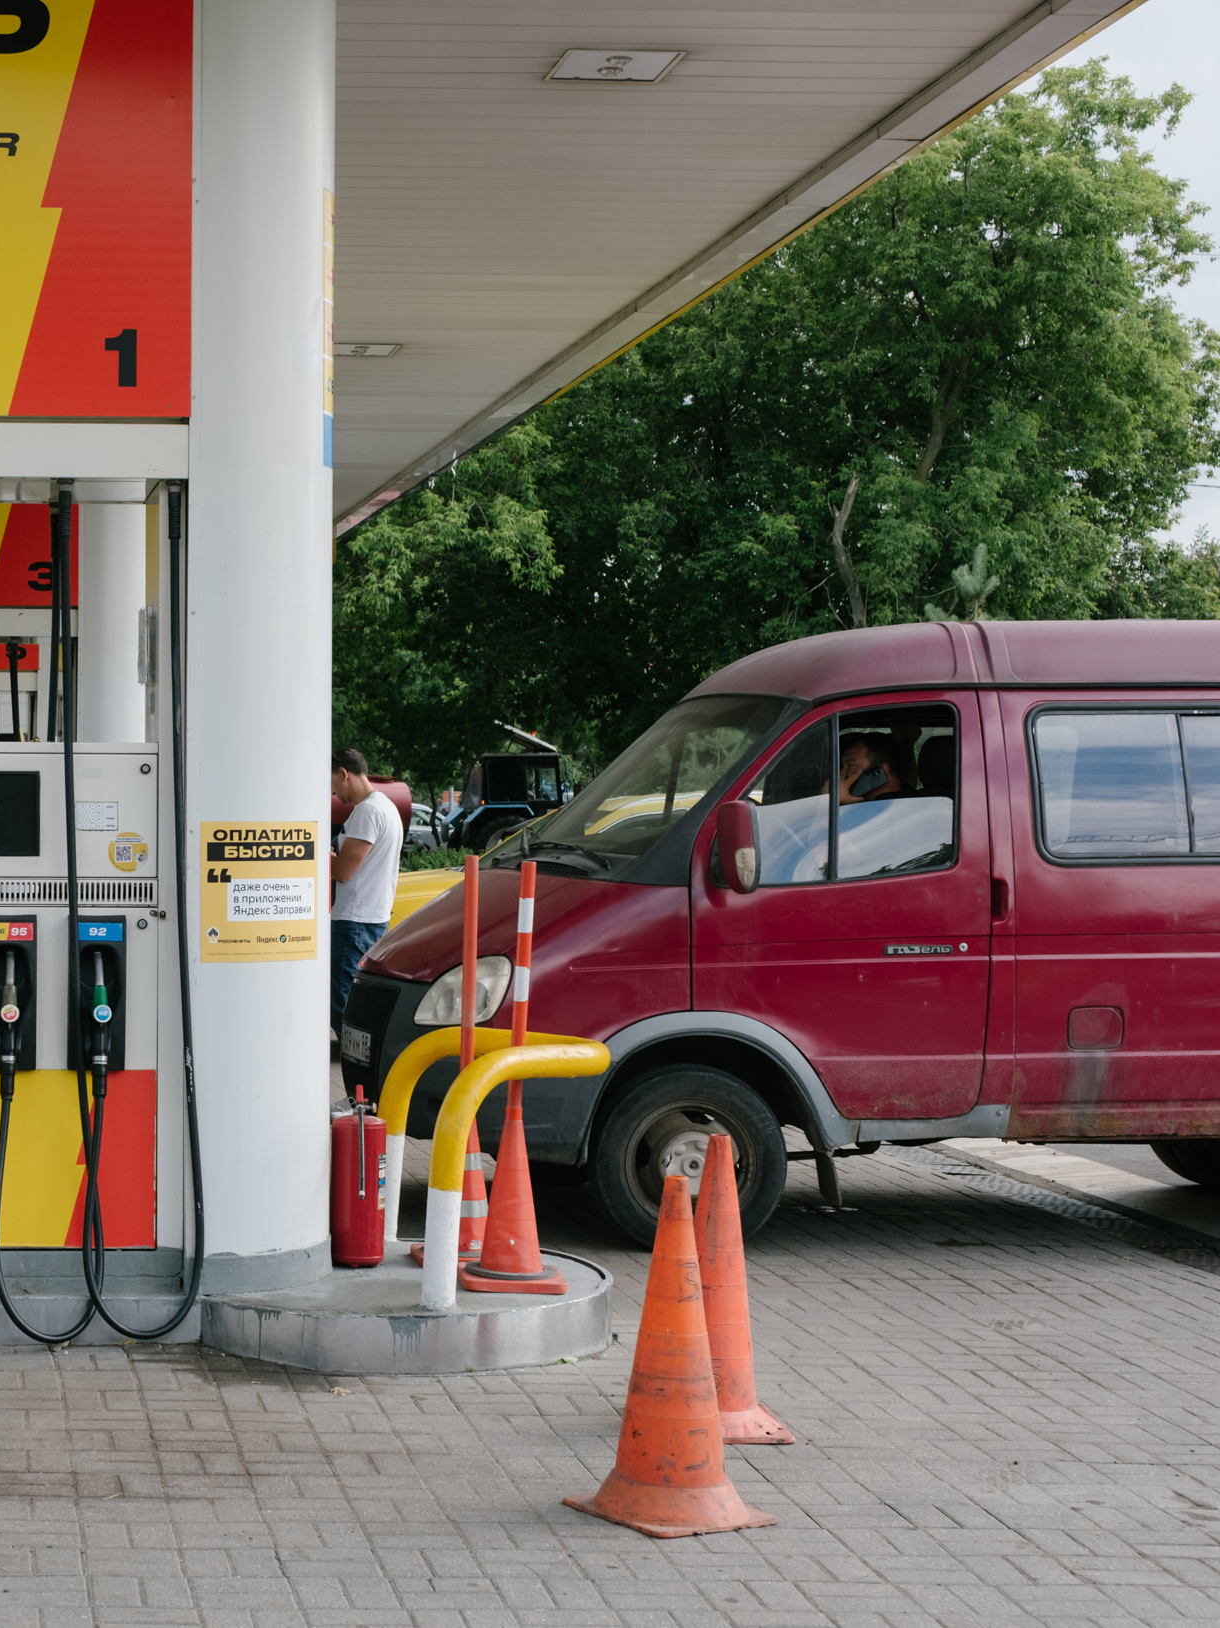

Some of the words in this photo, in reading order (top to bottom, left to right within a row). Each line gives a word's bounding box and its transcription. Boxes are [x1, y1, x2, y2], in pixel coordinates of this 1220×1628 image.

[104, 329, 137, 387] 1
[213, 829, 312, 842] ОПЛАТИТЬ
[224, 845, 305, 858] БЫСТРО
[233, 883, 261, 892] даже
[263, 882, 290, 891] очень
[242, 894, 302, 905] приложении
[233, 905, 271, 916] Яндекс
[273, 905, 312, 916] Заправки
[10, 928, 28, 936] 95
[88, 928, 107, 936] 92
